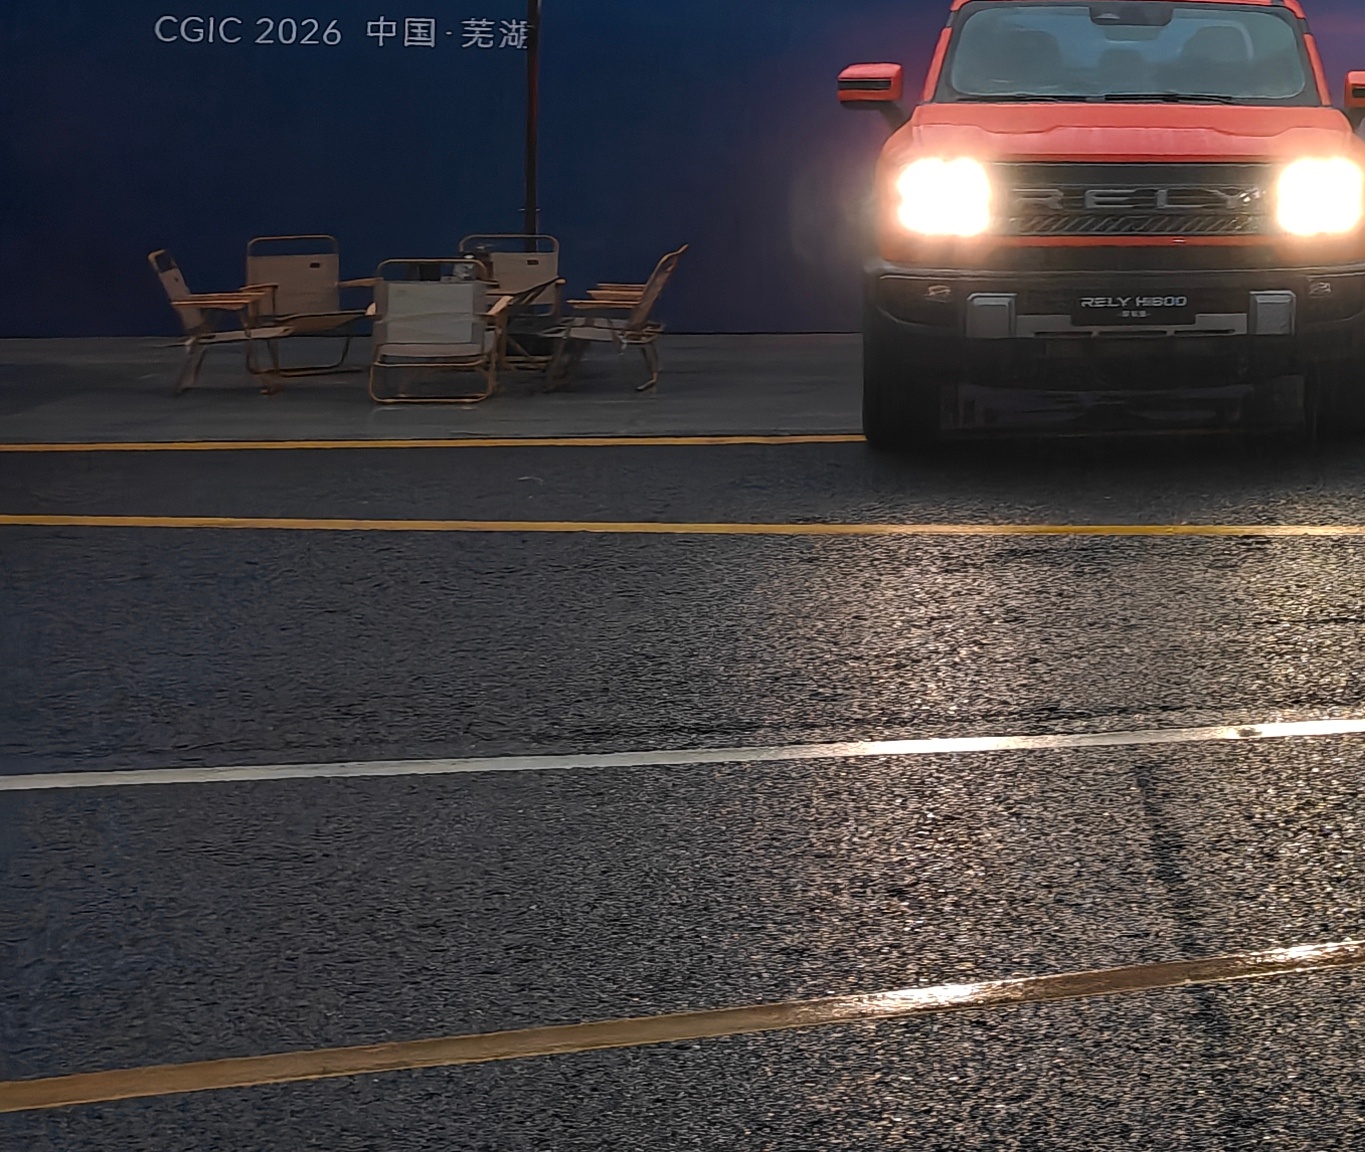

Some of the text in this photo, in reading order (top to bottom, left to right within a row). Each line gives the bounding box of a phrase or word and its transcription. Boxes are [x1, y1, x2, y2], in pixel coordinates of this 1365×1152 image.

[154, 15, 243, 44] CGIC
[254, 17, 342, 45] 2026
[1079, 296, 1132, 308] RELY
